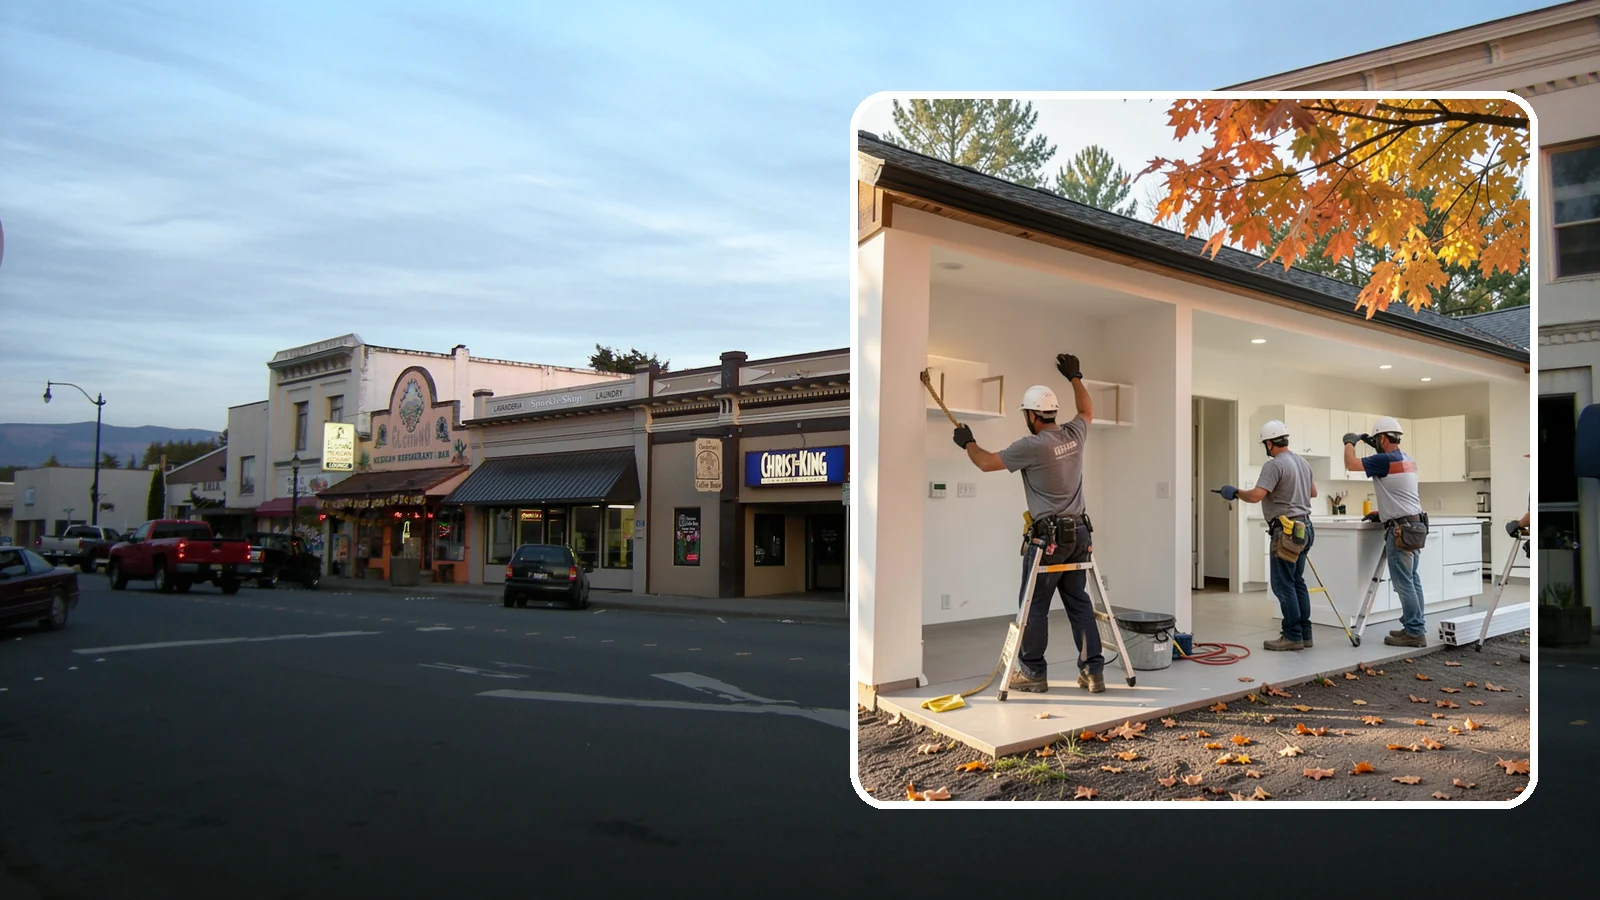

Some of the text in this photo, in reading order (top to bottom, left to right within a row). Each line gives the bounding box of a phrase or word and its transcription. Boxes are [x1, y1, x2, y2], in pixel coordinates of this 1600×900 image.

[494, 389, 624, 412] LAVANDERIA Sparkle Shop LAUNDRY
[374, 456, 396, 464] MEXICAN
[398, 452, 432, 462] RESTAURANT
[760, 450, 828, 478] CHRIST KING
